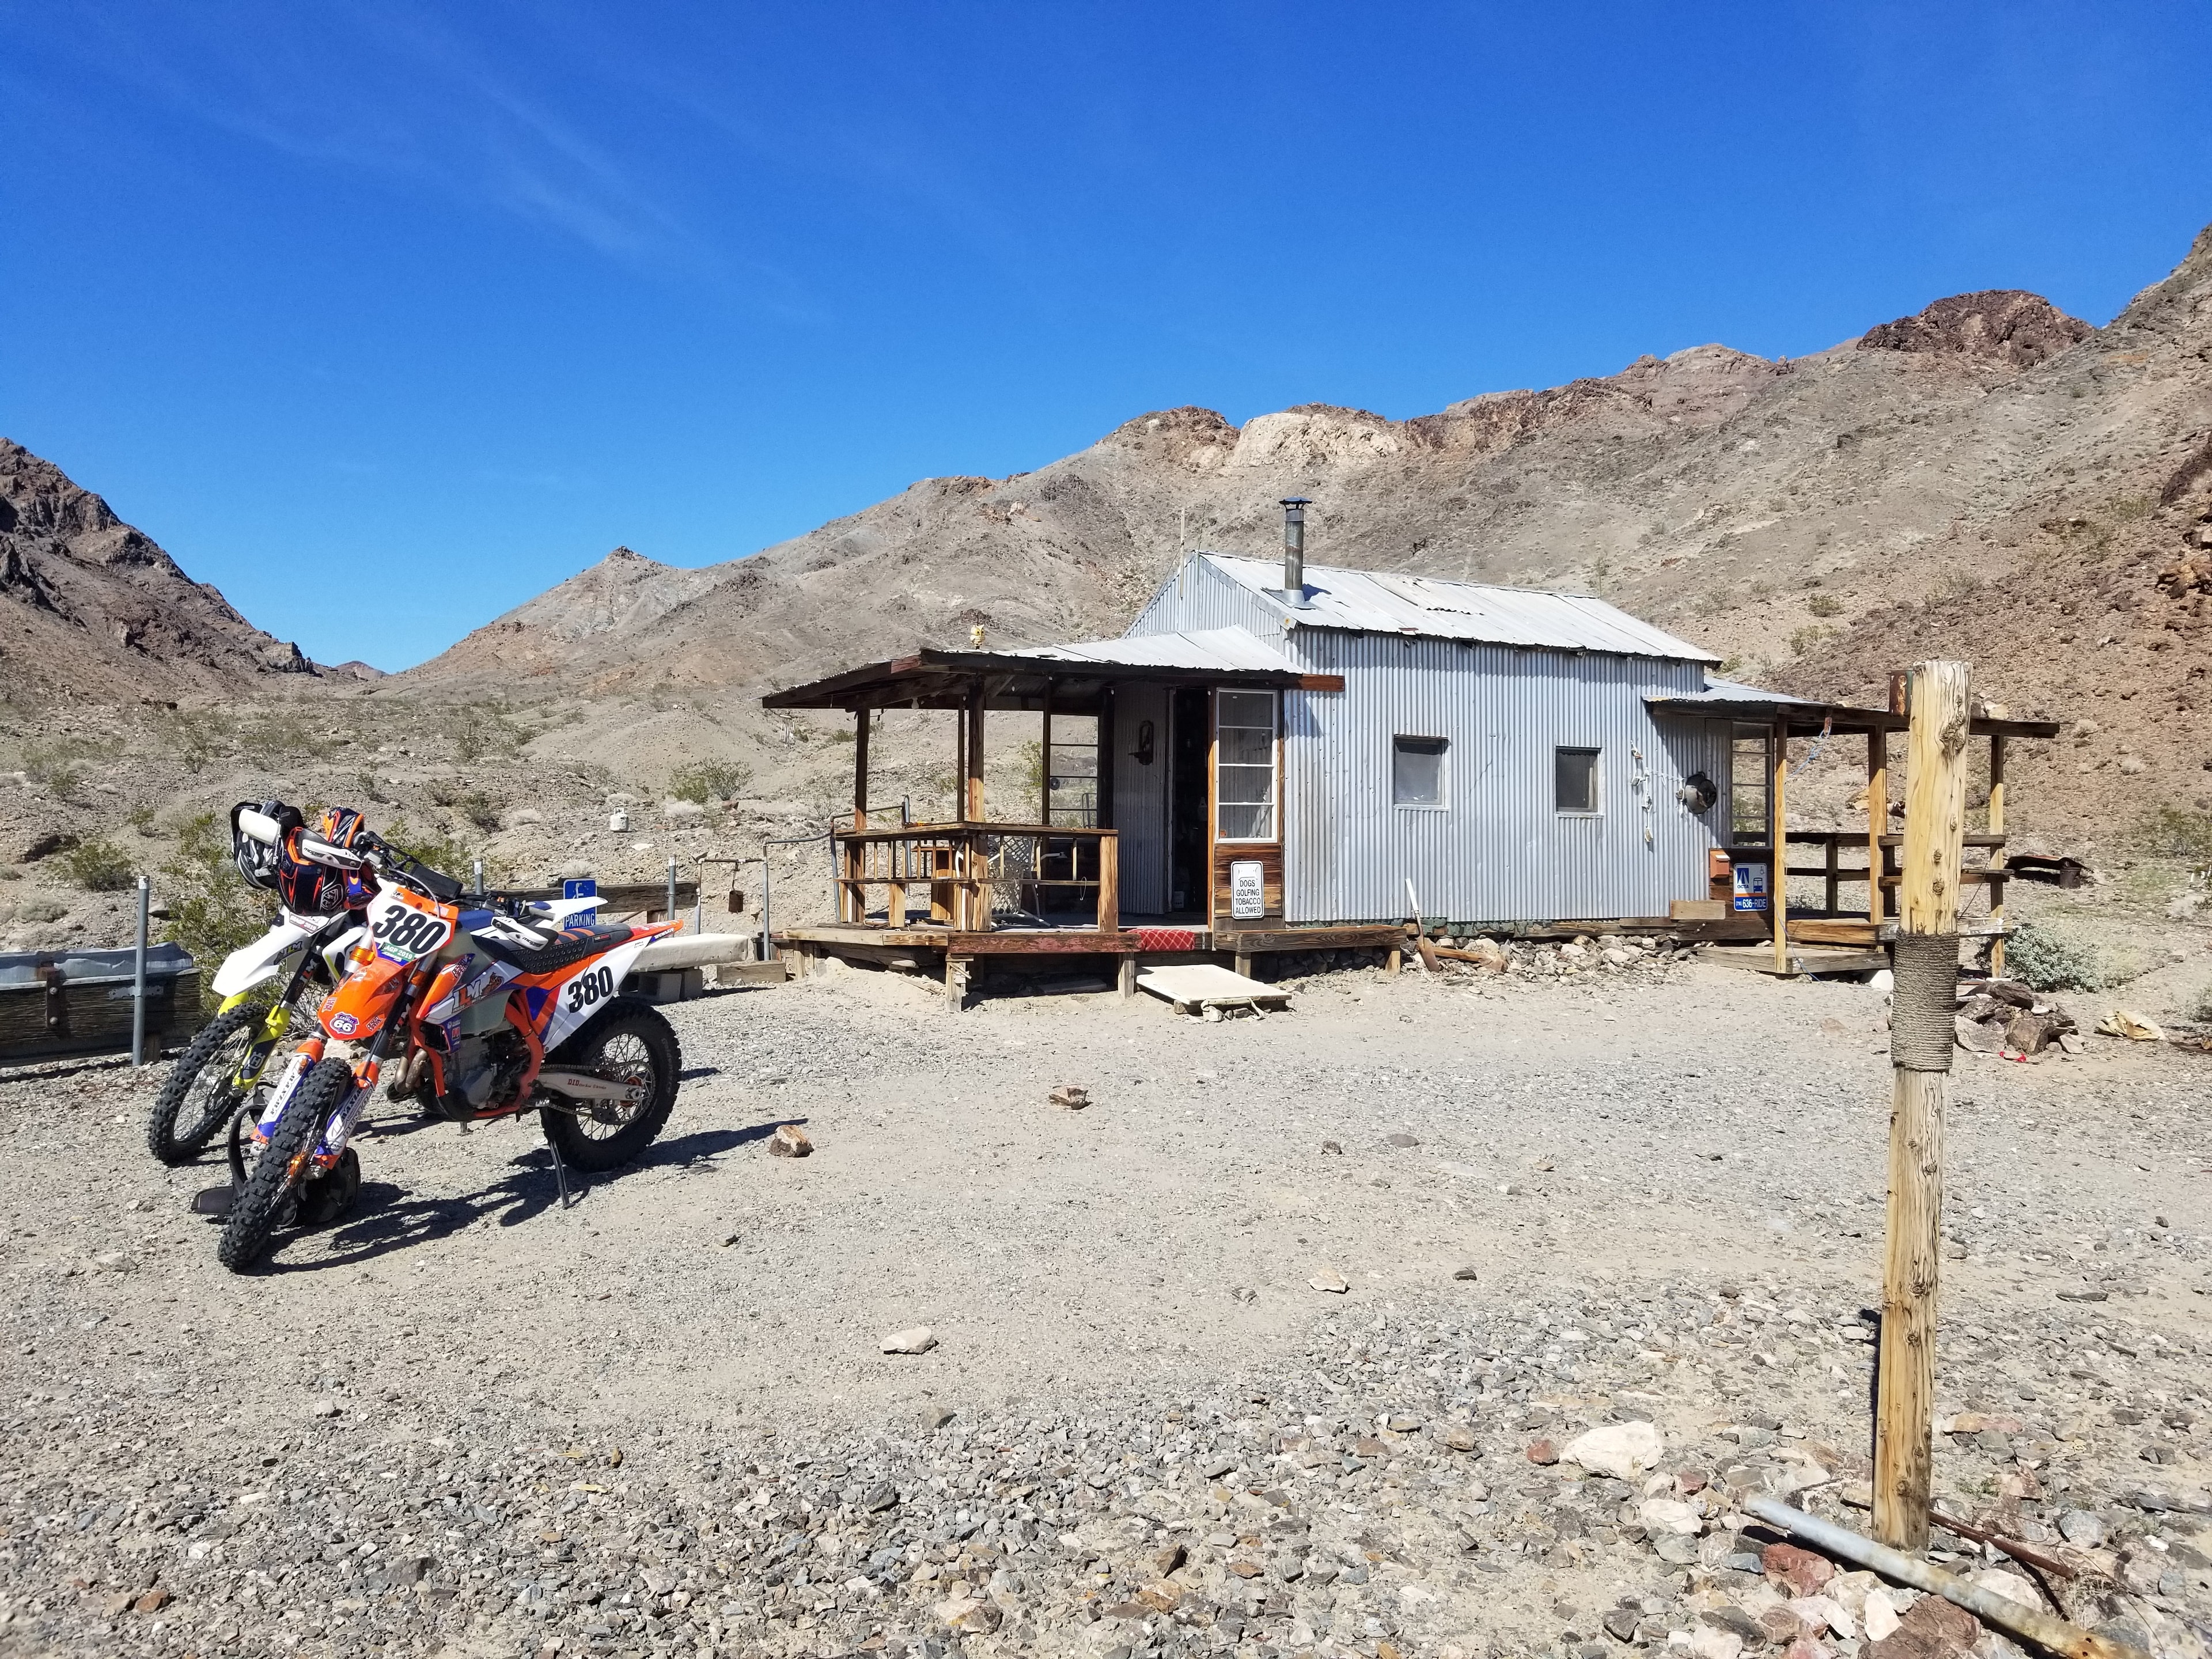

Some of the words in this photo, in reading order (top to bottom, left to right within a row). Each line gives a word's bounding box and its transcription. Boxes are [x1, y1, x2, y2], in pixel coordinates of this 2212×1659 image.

[1743, 899, 1766, 908] 636-RIDE
[304, 921, 317, 931] 2019
[565, 914, 595, 927] PARKING
[372, 904, 447, 955] 380
[654, 927, 675, 939] DUNLOP
[397, 949, 413, 960] 2019
[568, 966, 614, 1013] 380
[334, 1019, 353, 1032] 66
[567, 1078, 579, 1086] DID
